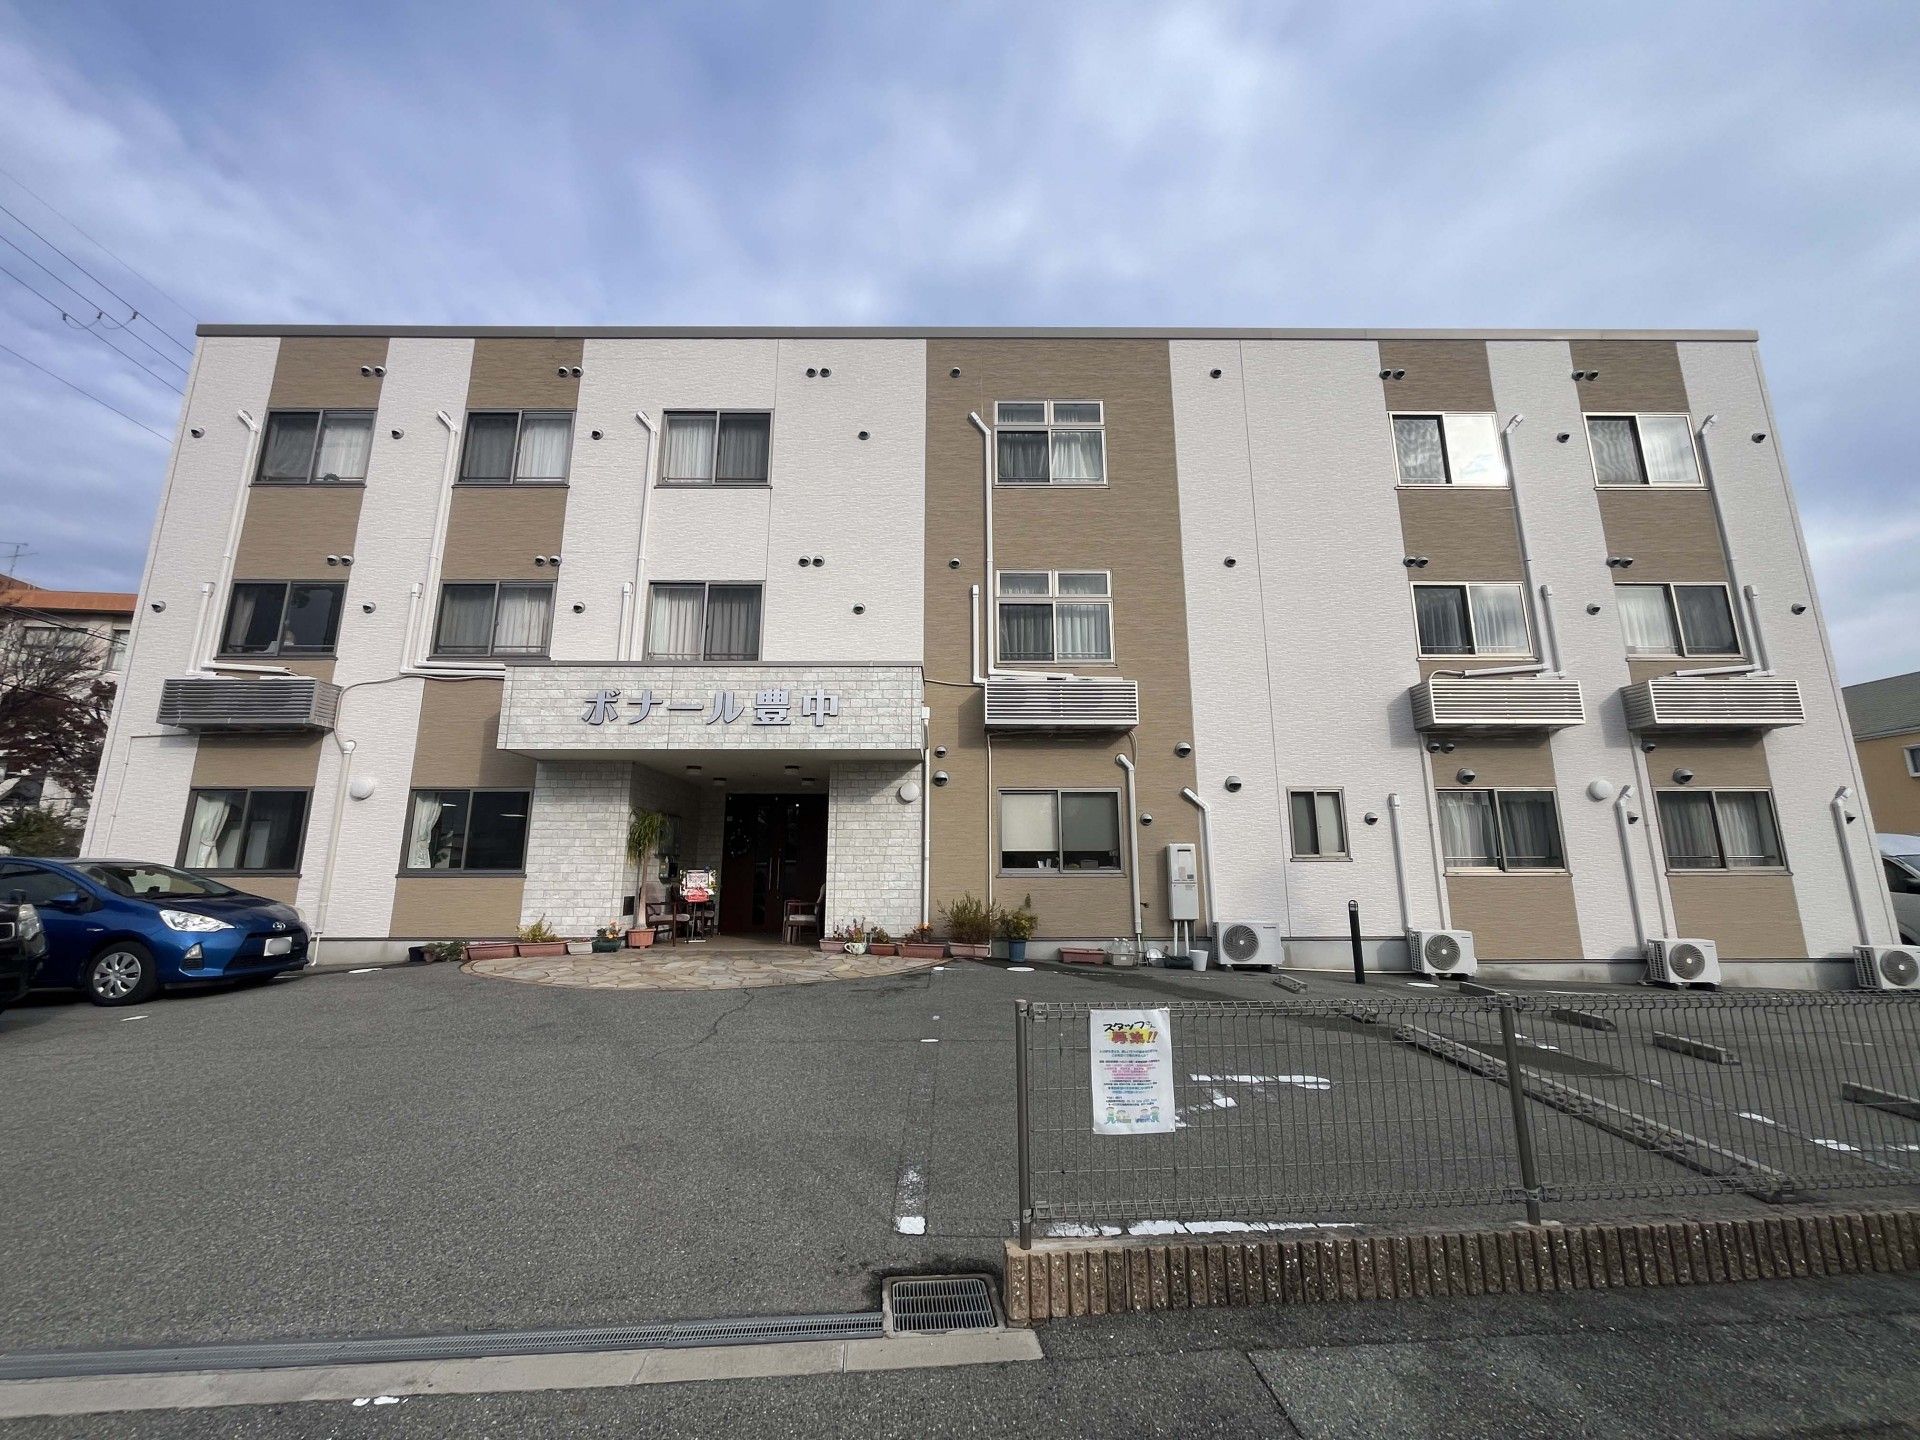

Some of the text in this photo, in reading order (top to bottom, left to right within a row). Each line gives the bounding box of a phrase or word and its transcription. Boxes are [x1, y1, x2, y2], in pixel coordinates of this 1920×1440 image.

[581, 688, 839, 727] ボナール豊中
